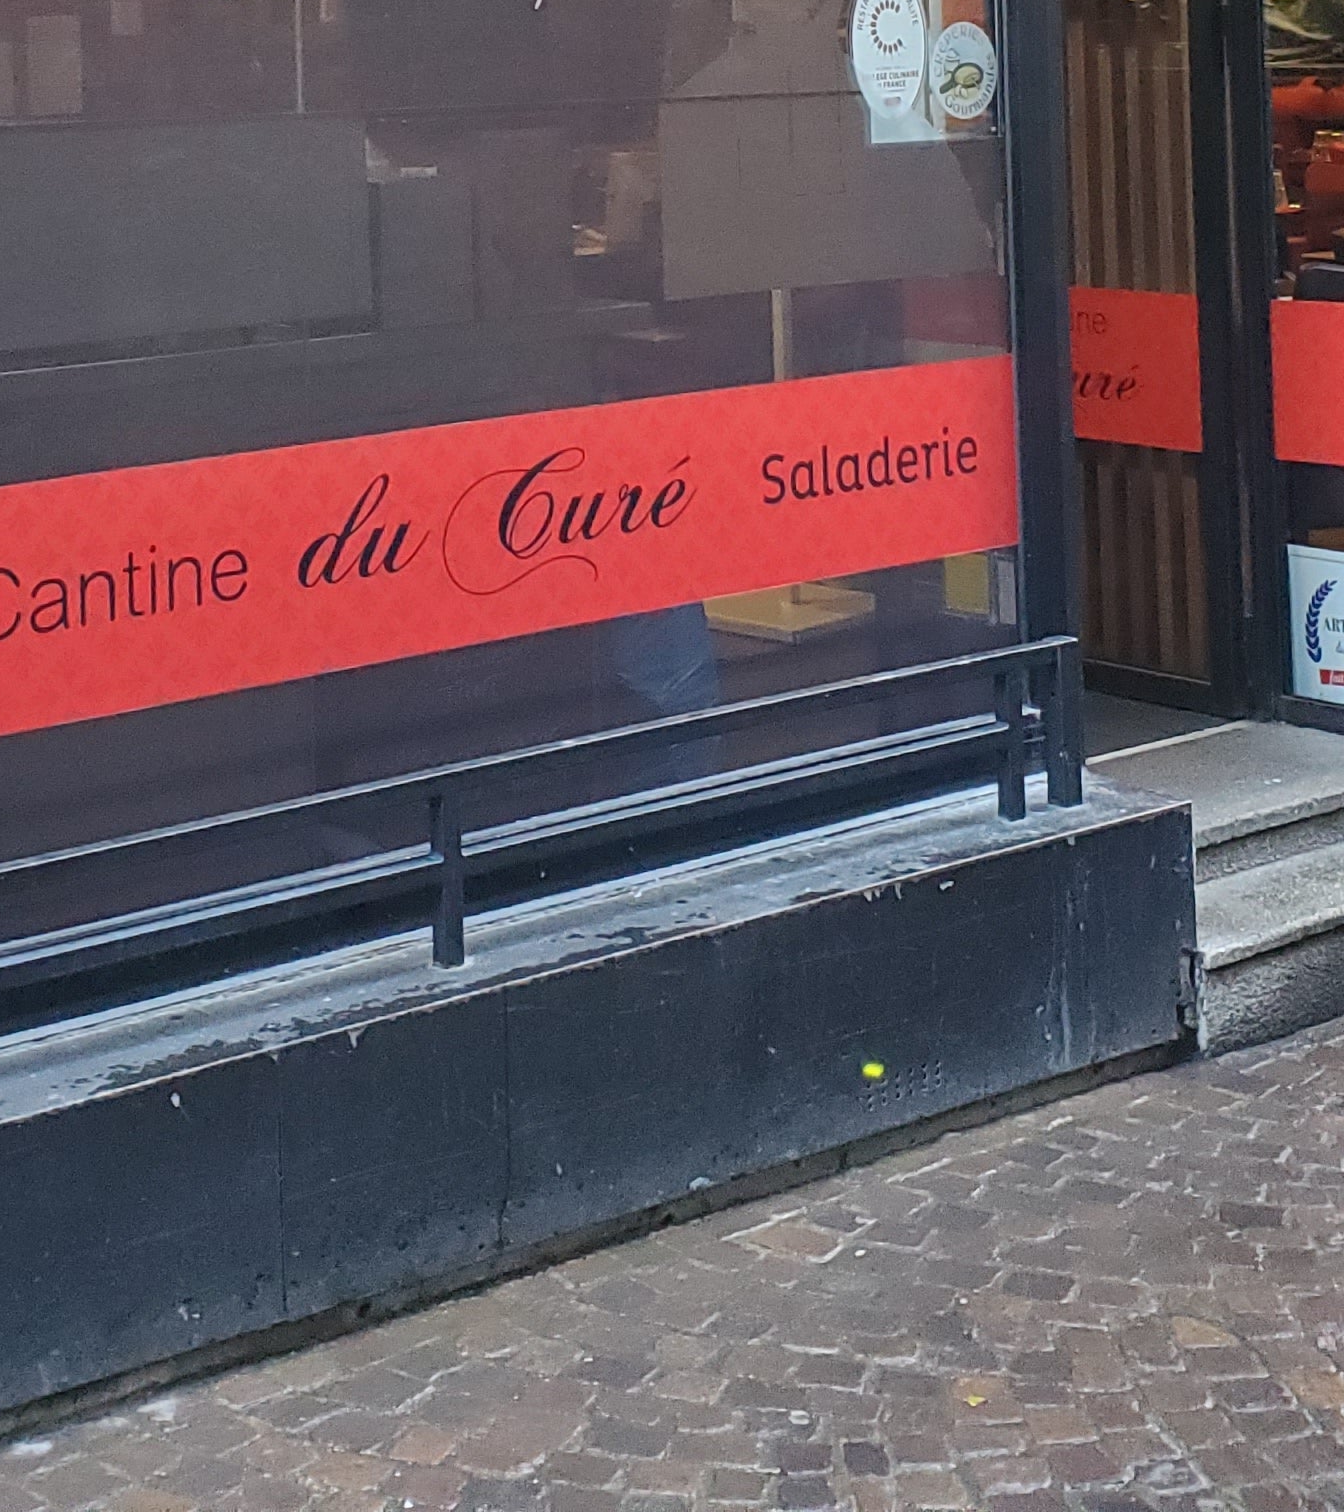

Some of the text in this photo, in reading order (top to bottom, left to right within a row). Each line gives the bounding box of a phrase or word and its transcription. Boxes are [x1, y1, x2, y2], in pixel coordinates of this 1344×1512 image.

[296, 471, 427, 590] du
[442, 445, 699, 596] Curé
[760, 425, 980, 506] Saladerie
